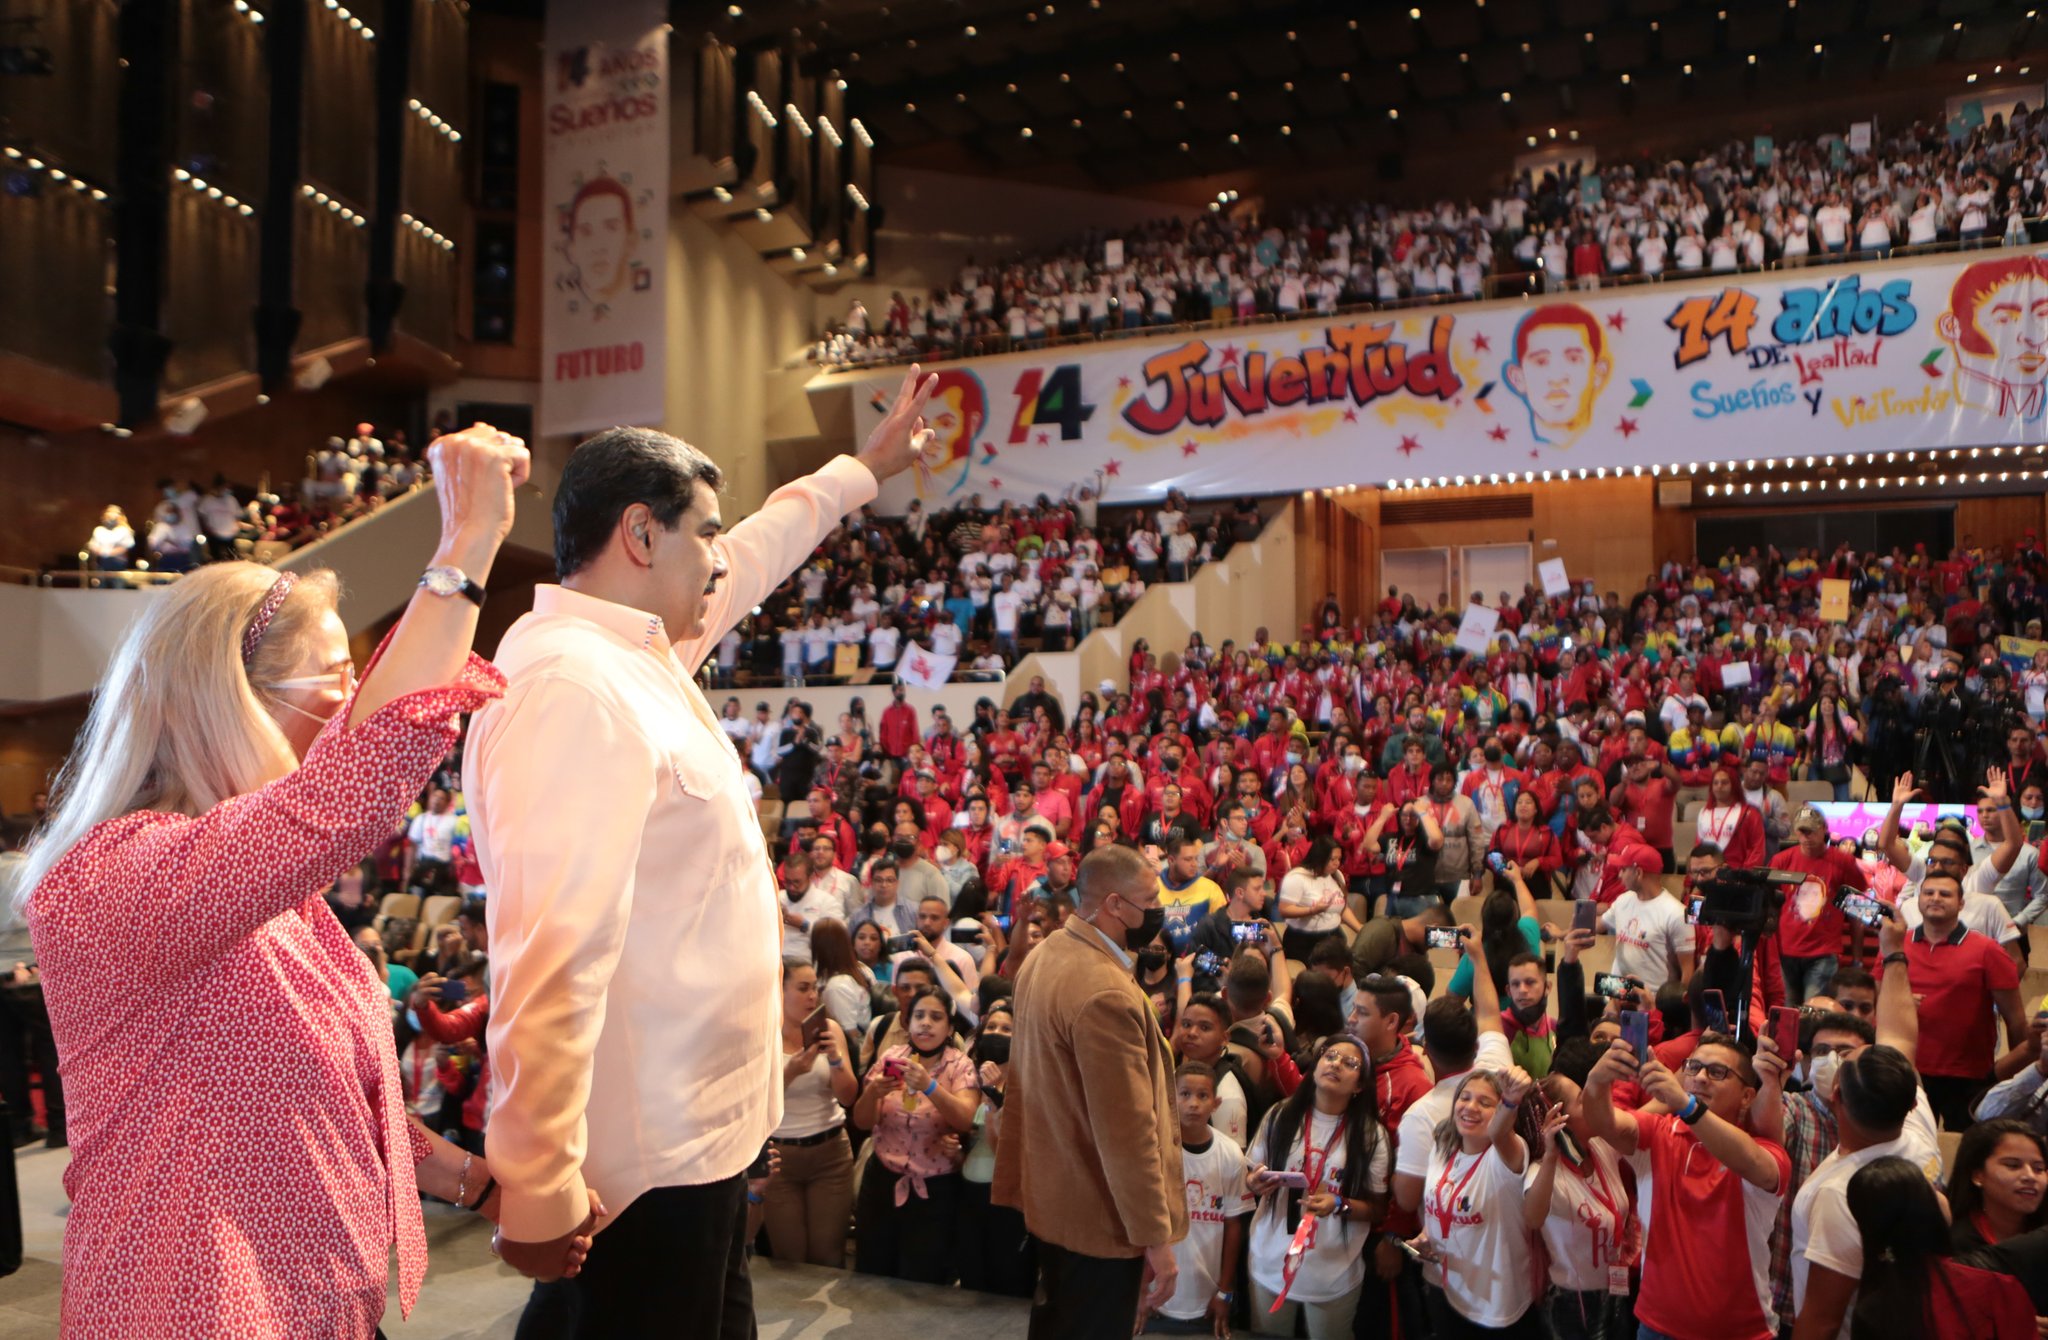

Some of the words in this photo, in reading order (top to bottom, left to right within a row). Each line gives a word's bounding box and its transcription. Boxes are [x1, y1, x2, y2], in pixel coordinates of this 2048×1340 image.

[1664, 286, 1760, 370] 14
[1770, 274, 1917, 346] años
[555, 340, 645, 382] FUTURO
[1746, 344, 1791, 370] DE
[1007, 363, 1098, 443] 14
[1689, 378, 1797, 419] Sueños
